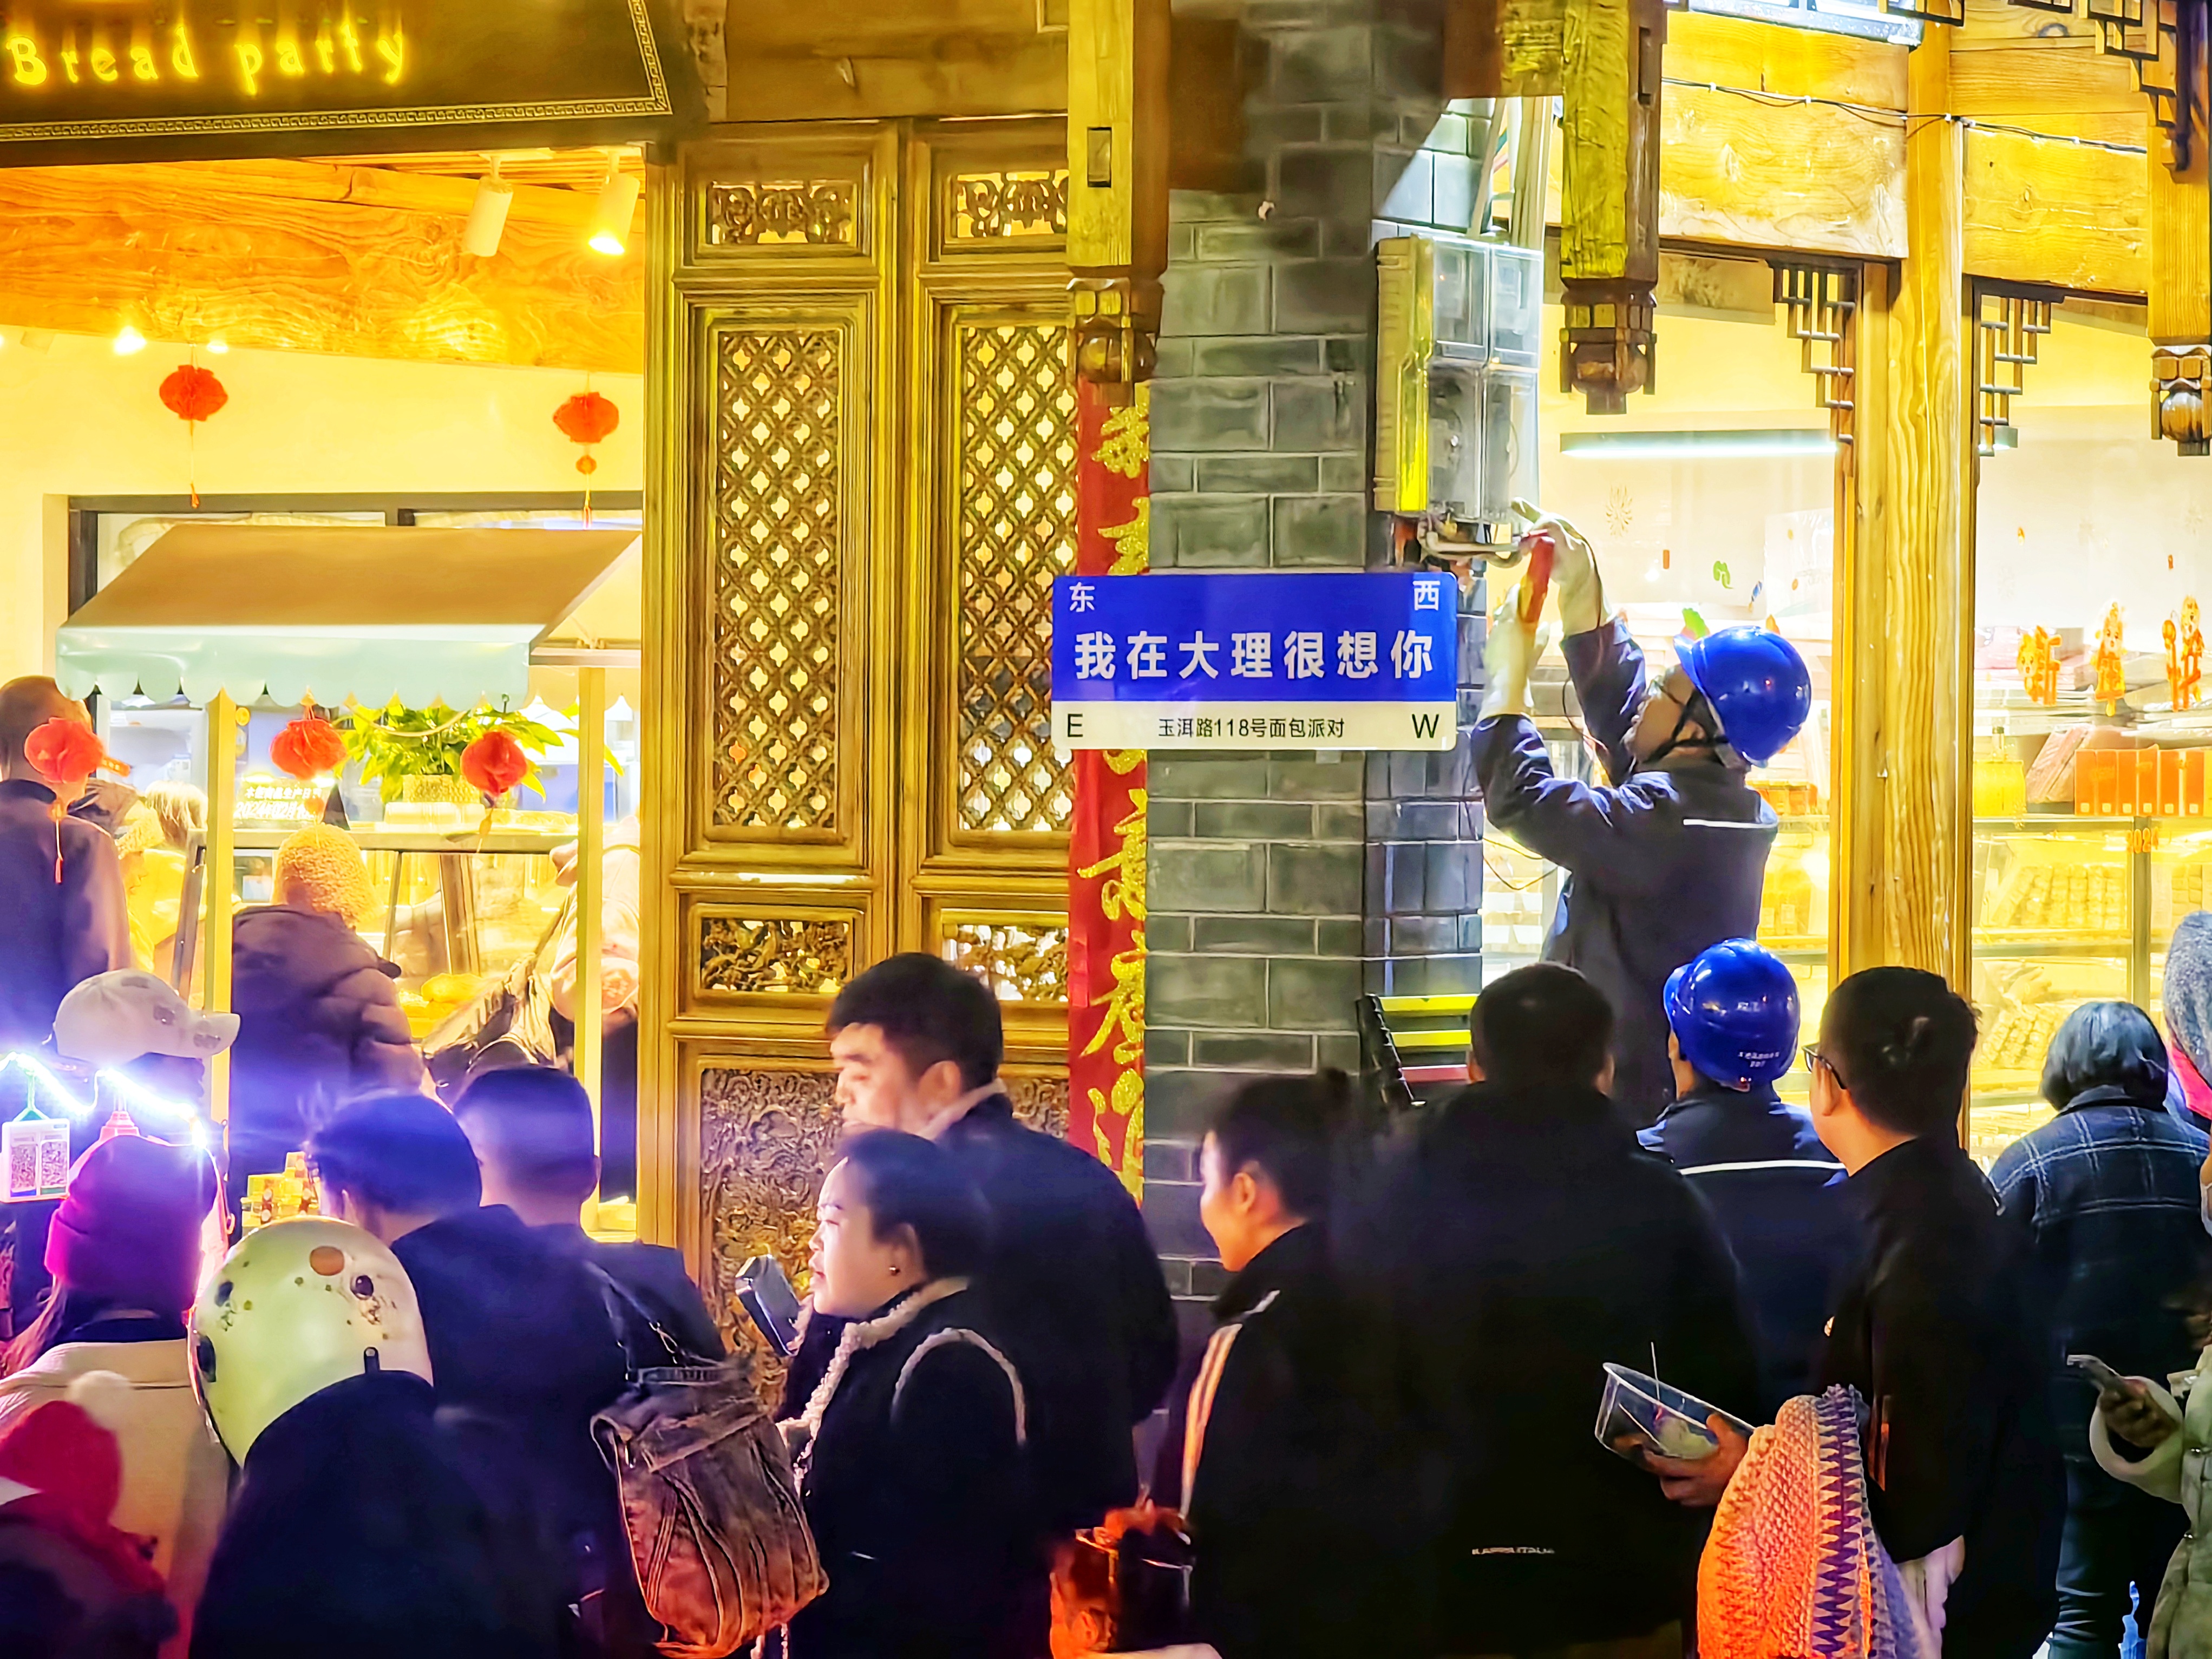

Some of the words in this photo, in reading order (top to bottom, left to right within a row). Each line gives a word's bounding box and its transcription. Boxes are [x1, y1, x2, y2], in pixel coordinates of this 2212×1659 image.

[5, 26, 199, 86] Bread
[234, 24, 403, 95] party
[1069, 581, 1096, 612] 东
[1412, 580, 1441, 611] 西
[1074, 629, 1434, 680] 我在大理很想你
[1066, 713, 1083, 738] E
[1157, 717, 1345, 738] 玉洱路118号面包派对
[1411, 713, 1440, 739] W
